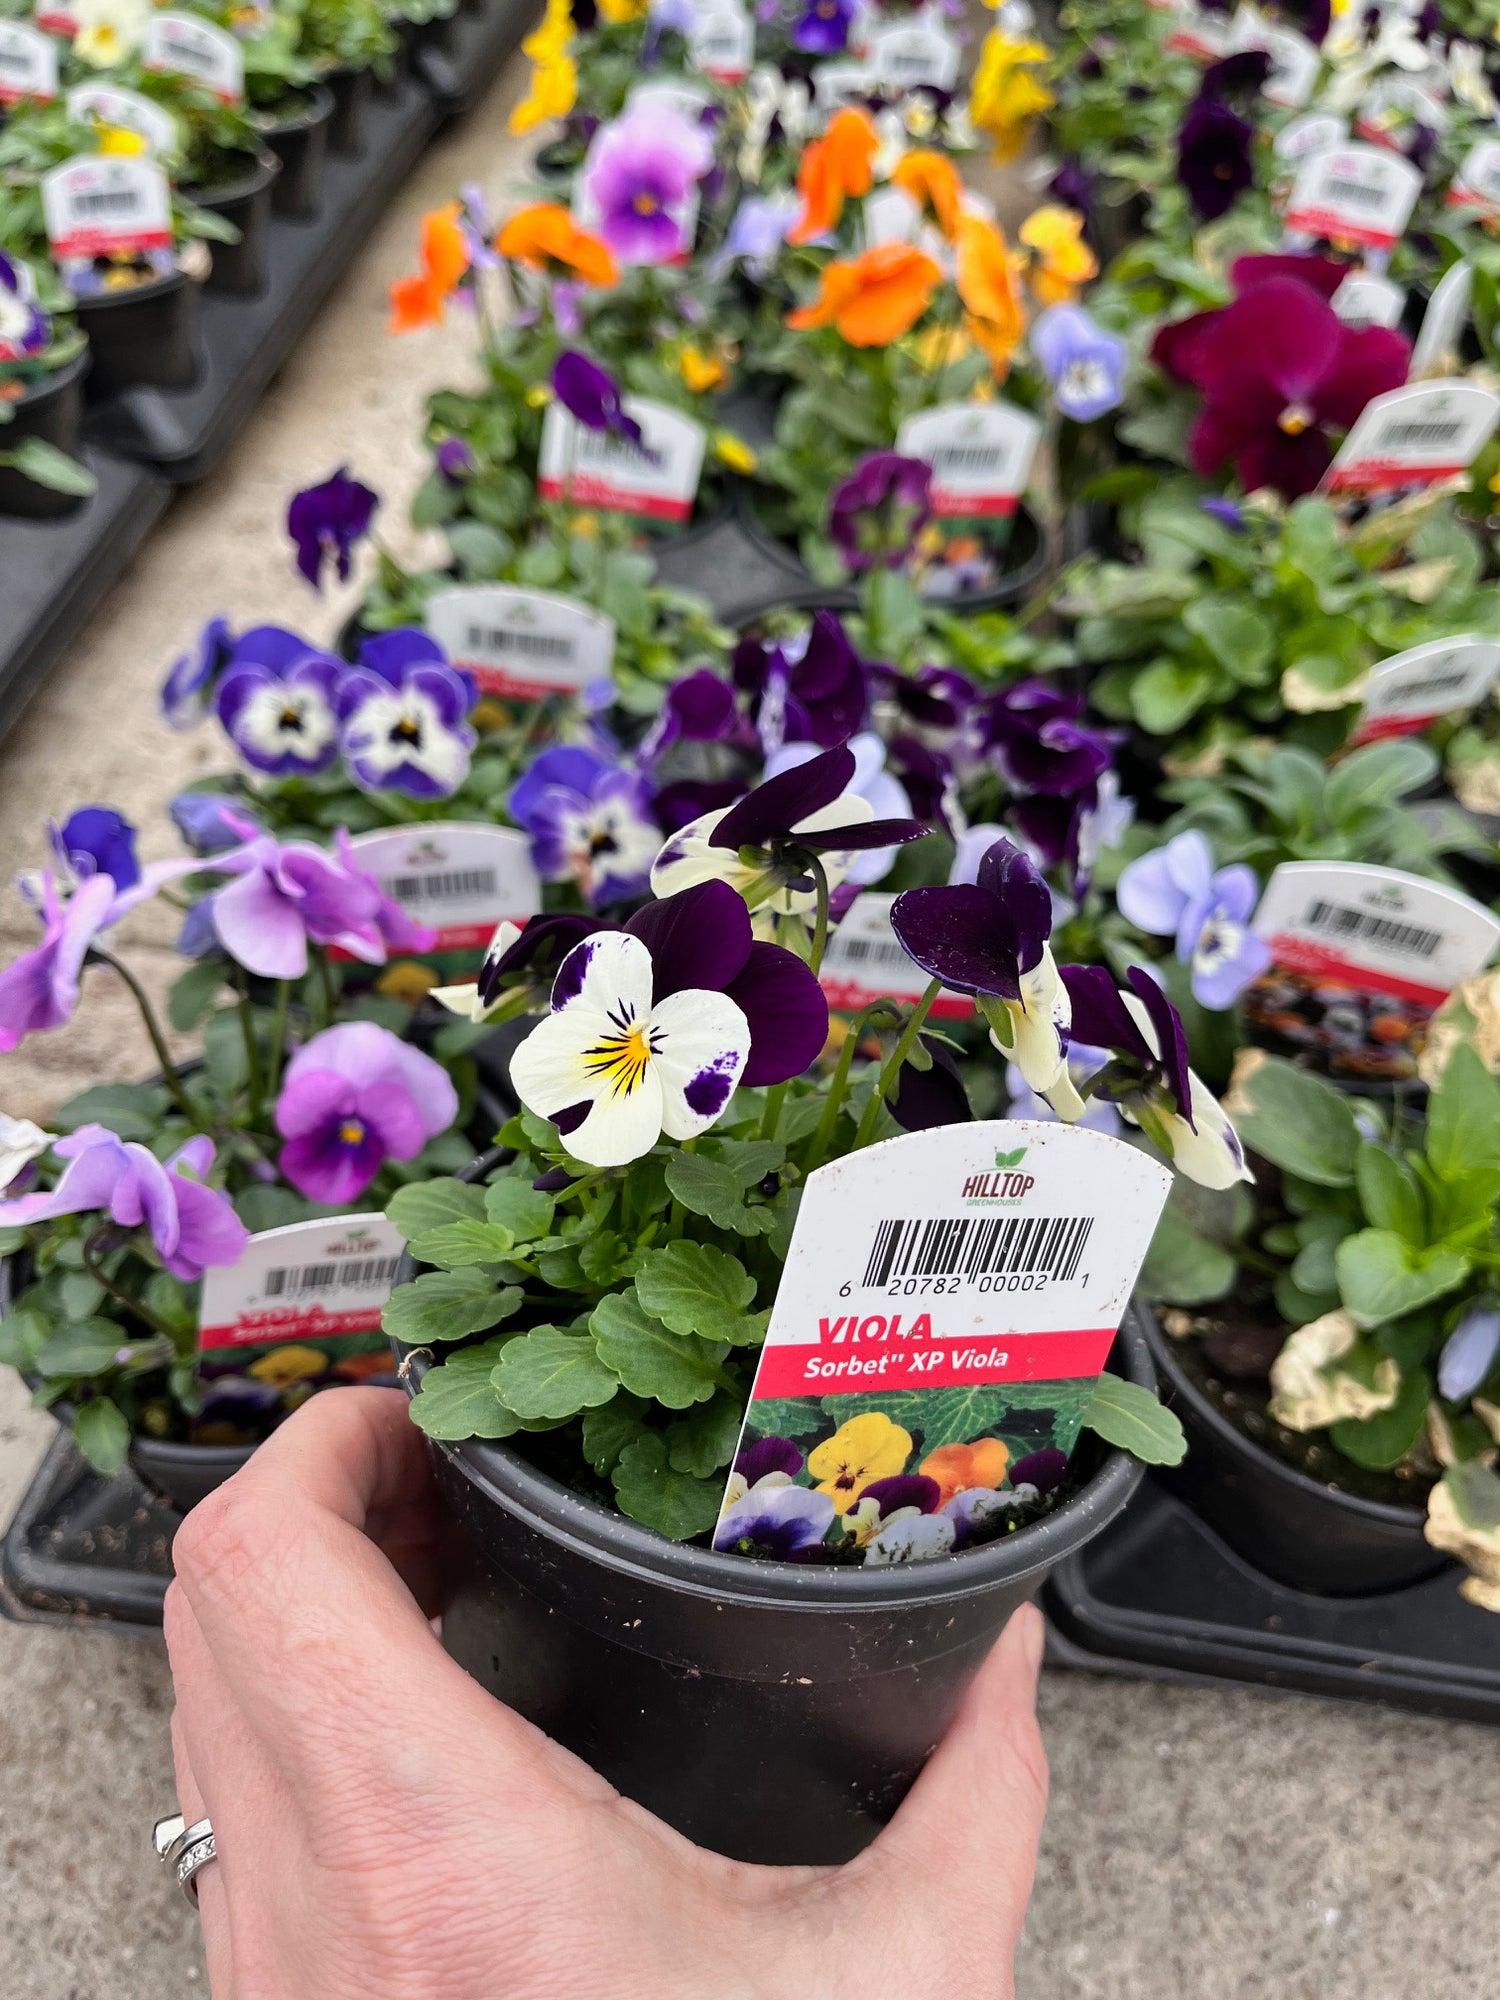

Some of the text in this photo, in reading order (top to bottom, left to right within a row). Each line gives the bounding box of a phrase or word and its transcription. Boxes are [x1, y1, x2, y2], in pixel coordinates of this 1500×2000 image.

[961, 1172, 1035, 1198] HILLTOP
[966, 1198, 1023, 1207] GREENHOUSES
[838, 1273, 1090, 1298] 6 20782 00002 1
[818, 1313, 933, 1344] VIOLA
[906, 1350, 945, 1372] XP
[951, 1347, 1009, 1370] Viola
